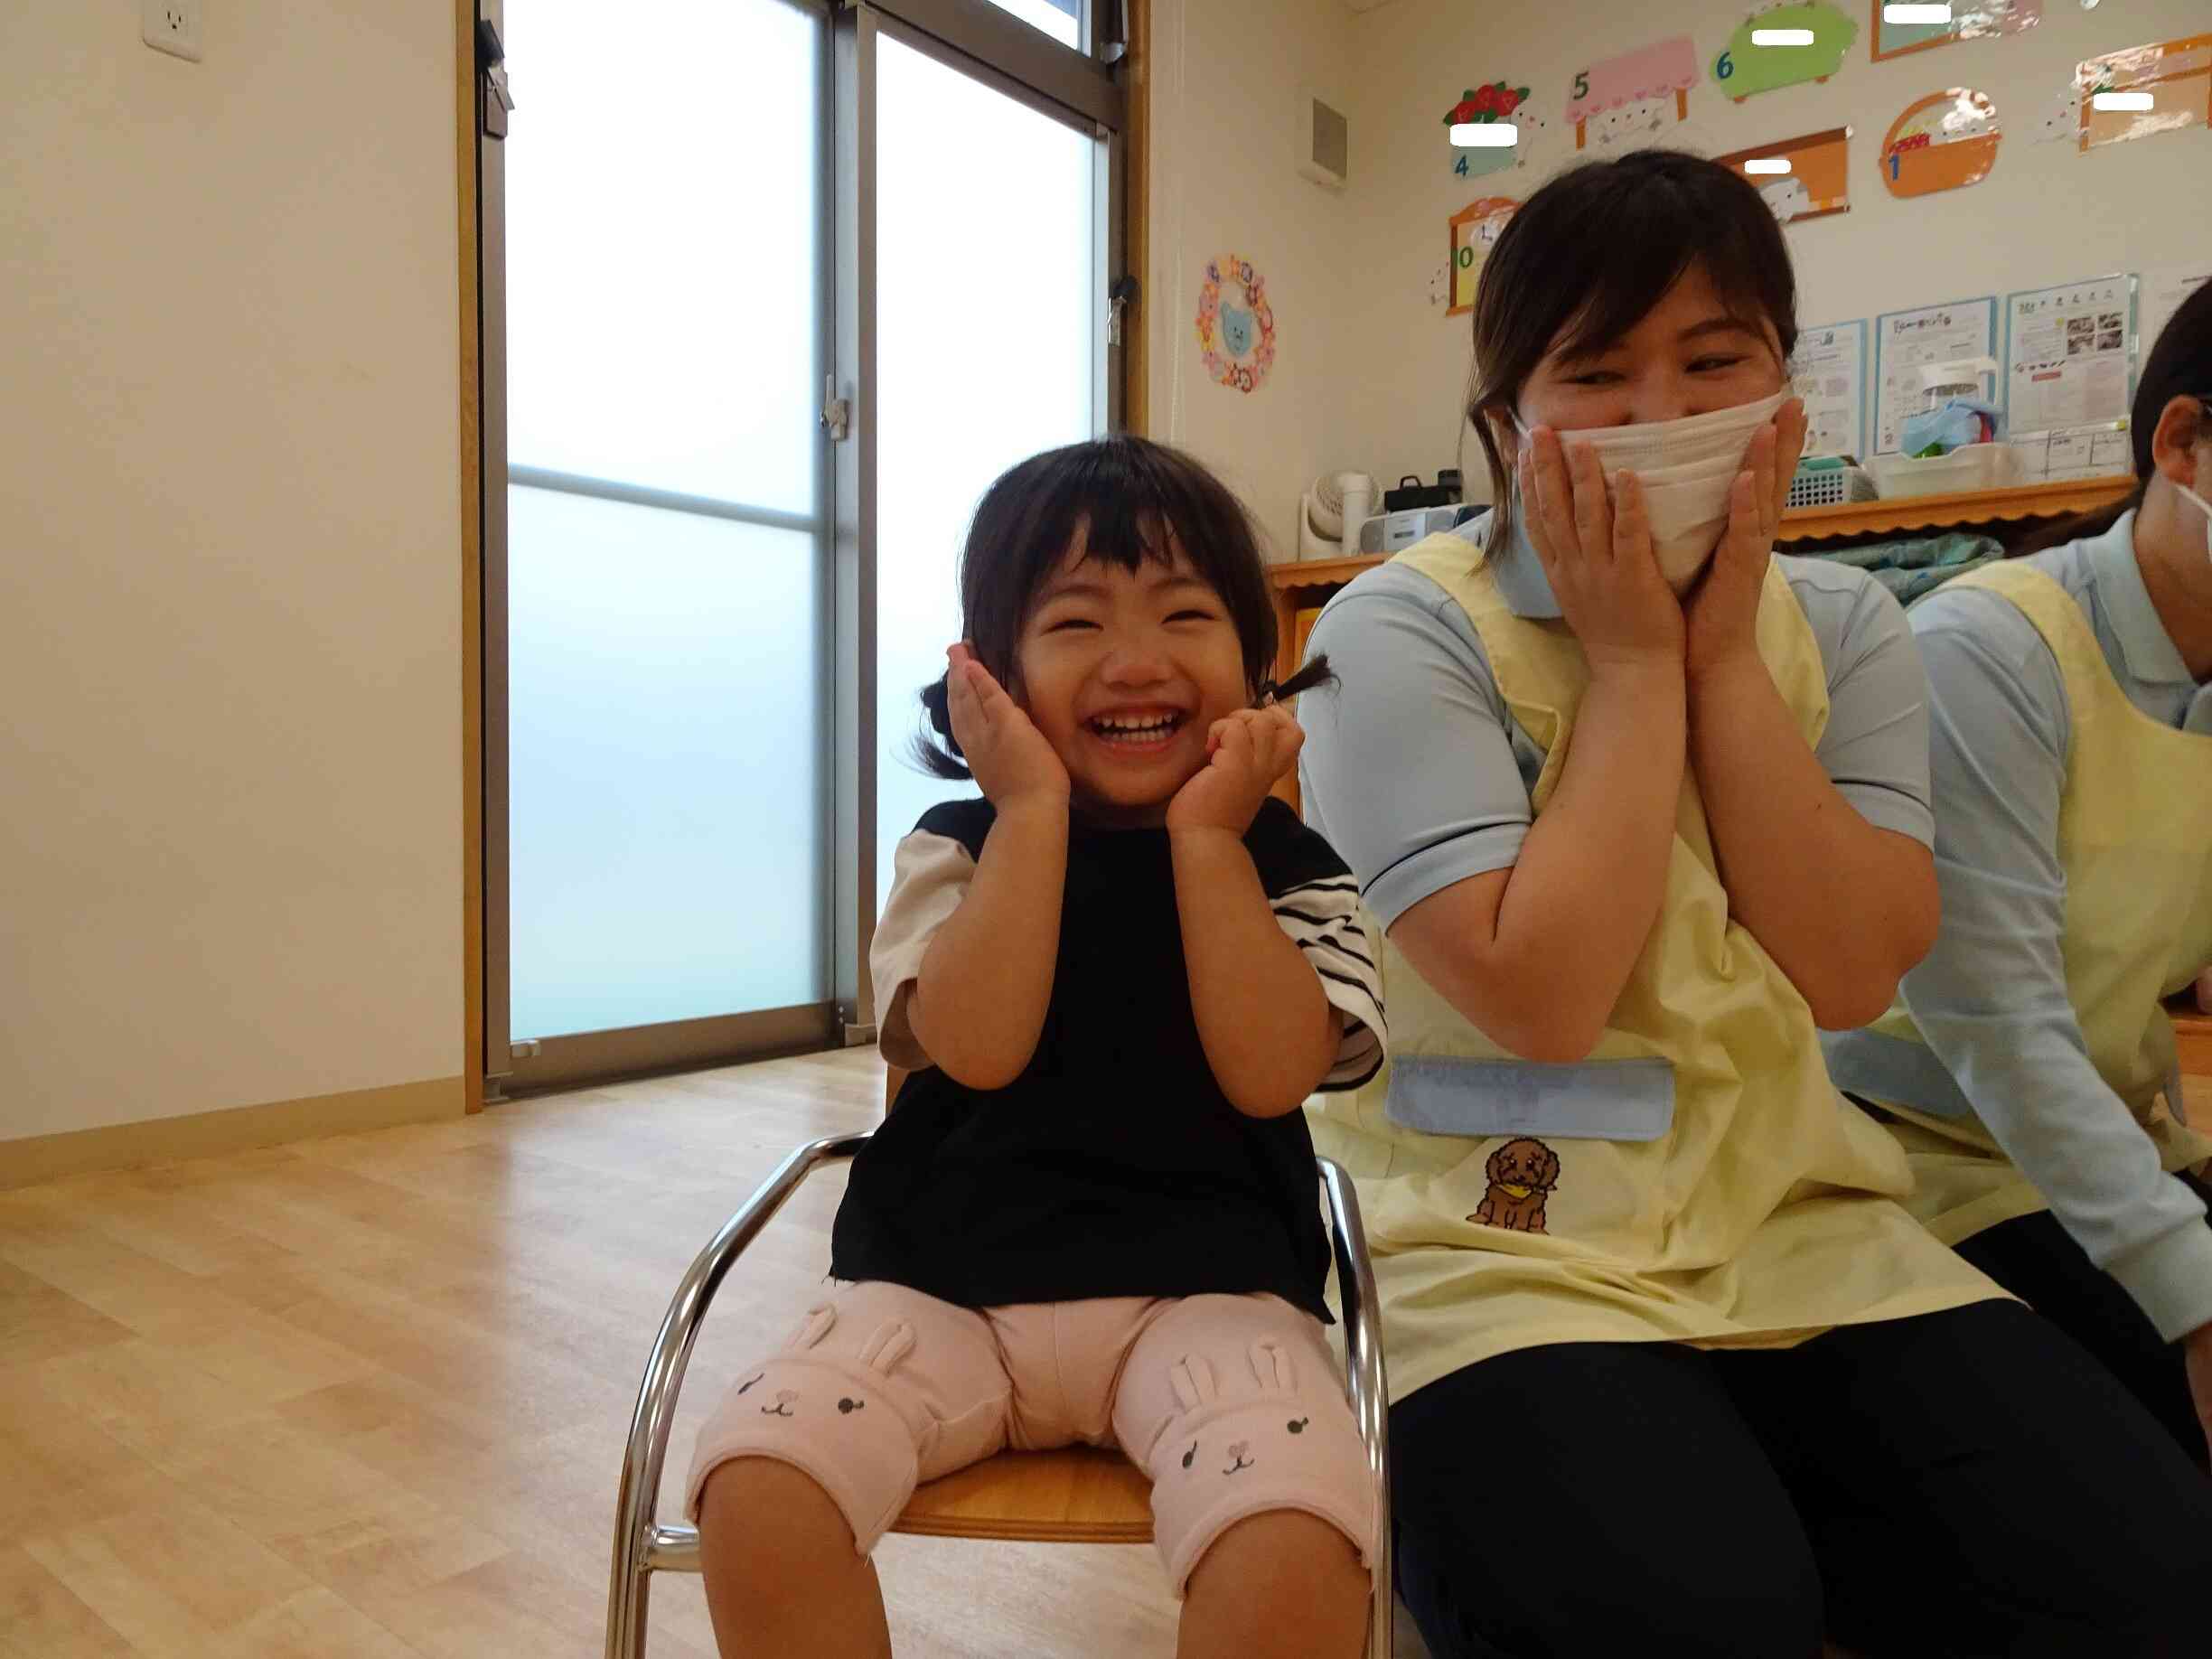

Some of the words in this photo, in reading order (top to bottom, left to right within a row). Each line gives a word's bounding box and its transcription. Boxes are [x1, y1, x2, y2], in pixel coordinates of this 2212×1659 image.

[1717, 52, 1734, 79] 6
[1573, 71, 1589, 99] 5
[1455, 155, 1468, 176] 4
[1889, 154, 1898, 181] 1
